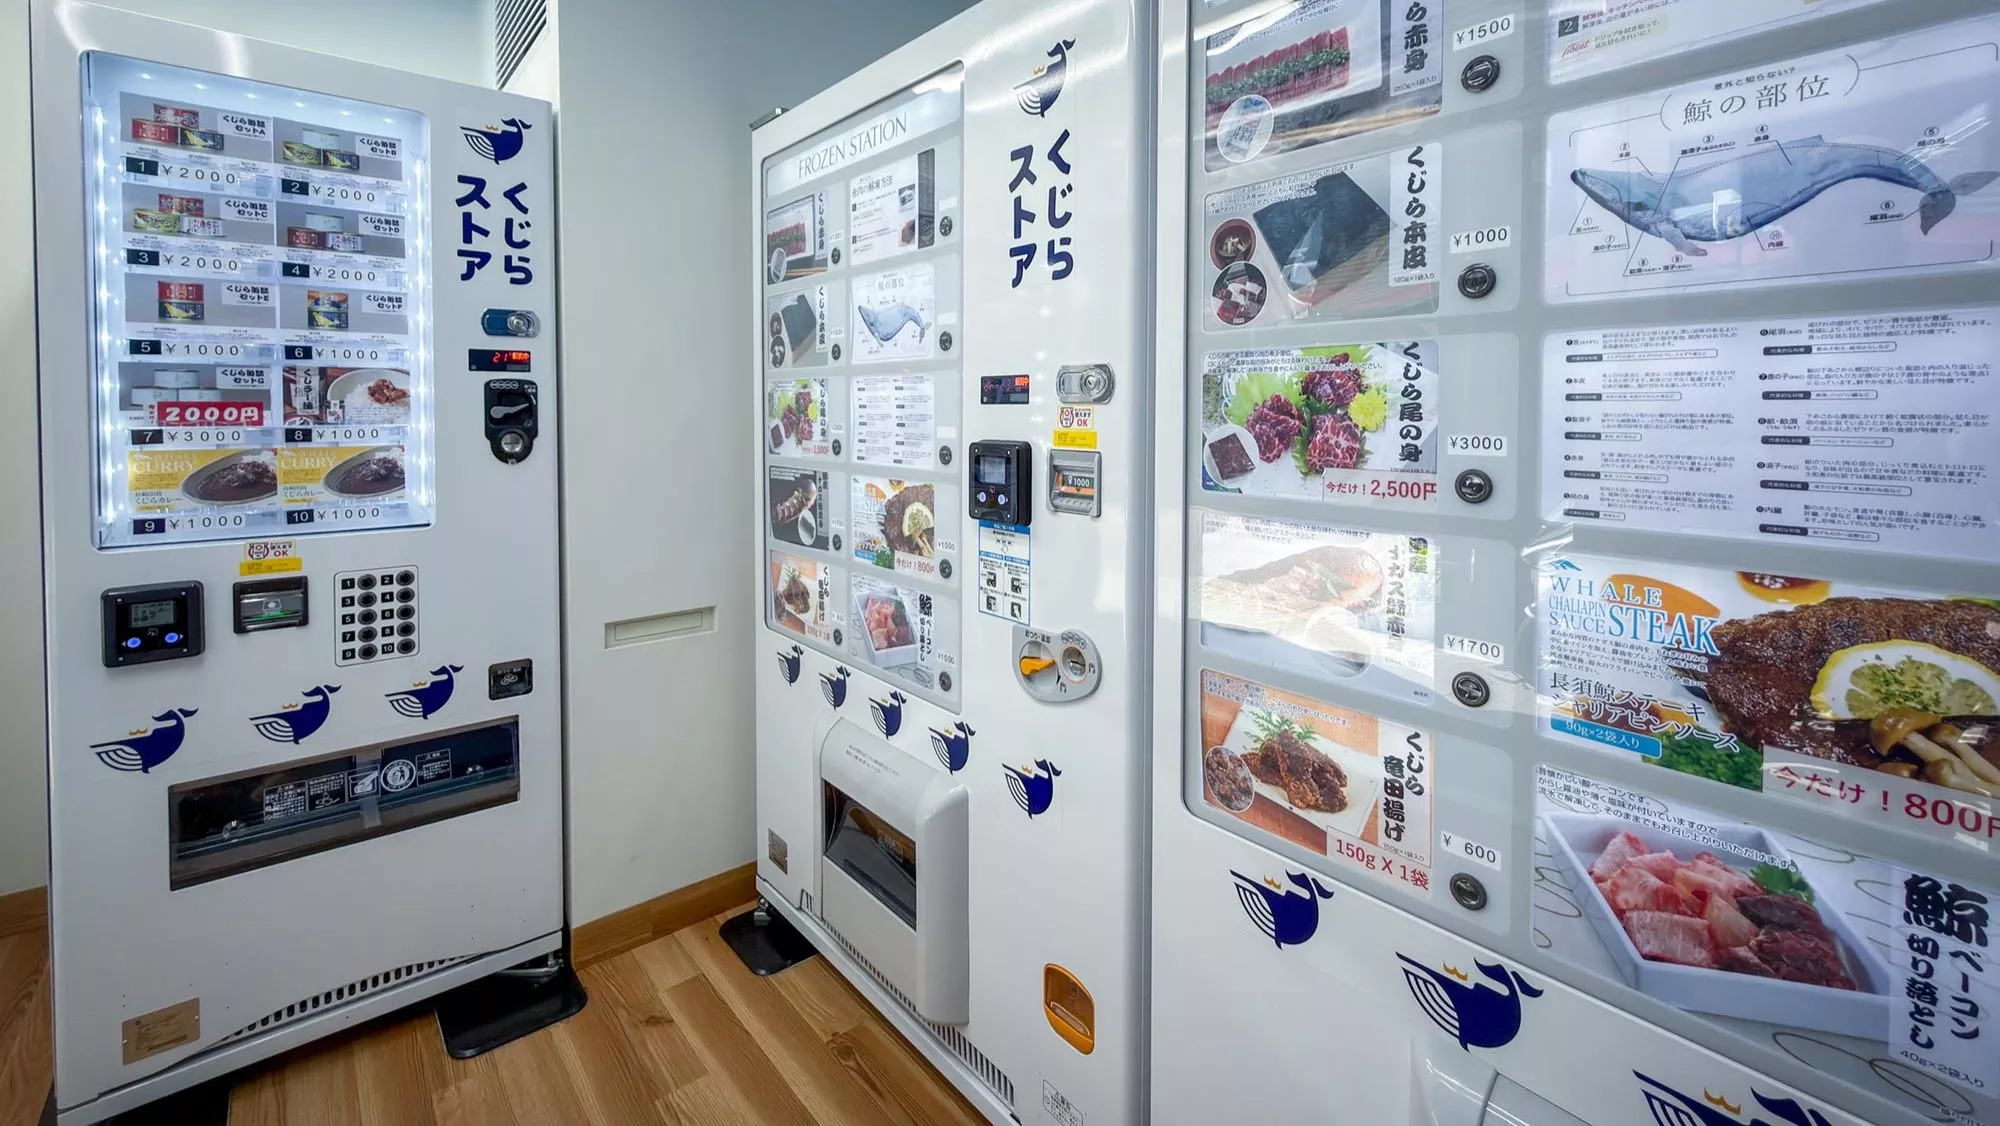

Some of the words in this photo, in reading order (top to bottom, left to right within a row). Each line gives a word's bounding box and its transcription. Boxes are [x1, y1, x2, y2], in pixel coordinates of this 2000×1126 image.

[1456, 17, 1510, 44] ¥1500
[1563, 20, 1574, 32] 2
[1682, 75, 1830, 126] 鯨の部位
[798, 140, 846, 180] FROZEN
[849, 112, 907, 156] STATION
[137, 161, 145, 173] 1
[291, 182, 300, 193] 2
[1008, 145, 1037, 288] ストア
[1047, 128, 1074, 280] くじら
[1402, 145, 1427, 270] くじら本皮
[455, 174, 492, 281] ストア
[503, 181, 533, 285] くじら
[1453, 227, 1508, 247] ¥1000
[139, 252, 148, 263] 3
[292, 266, 300, 276] 4
[141, 342, 151, 352] 5
[294, 348, 304, 358] 6
[165, 406, 259, 422] 2000円
[1398, 341, 1424, 463] くじら尾の身
[294, 430, 303, 439] 8
[1077, 418, 1088, 427] OK
[142, 432, 152, 442] 7
[1450, 436, 1502, 451] ¥3000
[133, 461, 193, 473] CURRY
[281, 457, 335, 469] CURRY
[144, 521, 155, 532] 9
[293, 512, 308, 523] 10
[1550, 575, 1662, 607] WHALE
[1549, 594, 1606, 618] CHALIAPIN
[1549, 611, 1606, 634] SAUCE
[1608, 605, 1719, 655] STEAK
[1447, 636, 1501, 658] ¥1700
[1550, 671, 1708, 722] 長須鯨ステーキ
[1551, 692, 1739, 752] シャリアピンソース
[1566, 718, 1640, 749] 90g×2袋入り
[1404, 731, 1425, 797] くじら
[1383, 755, 1405, 843] 竜田揚げ
[1336, 838, 1376, 870] 150g
[1400, 864, 1428, 891] 1袋
[1465, 843, 1497, 863] 600
[1904, 873, 1989, 947] 鯨
[1906, 932, 1940, 1050] 切り落とし
[1949, 950, 1984, 1040] ベーコン
[1900, 1049, 1984, 1089] 40g×2袋入り
